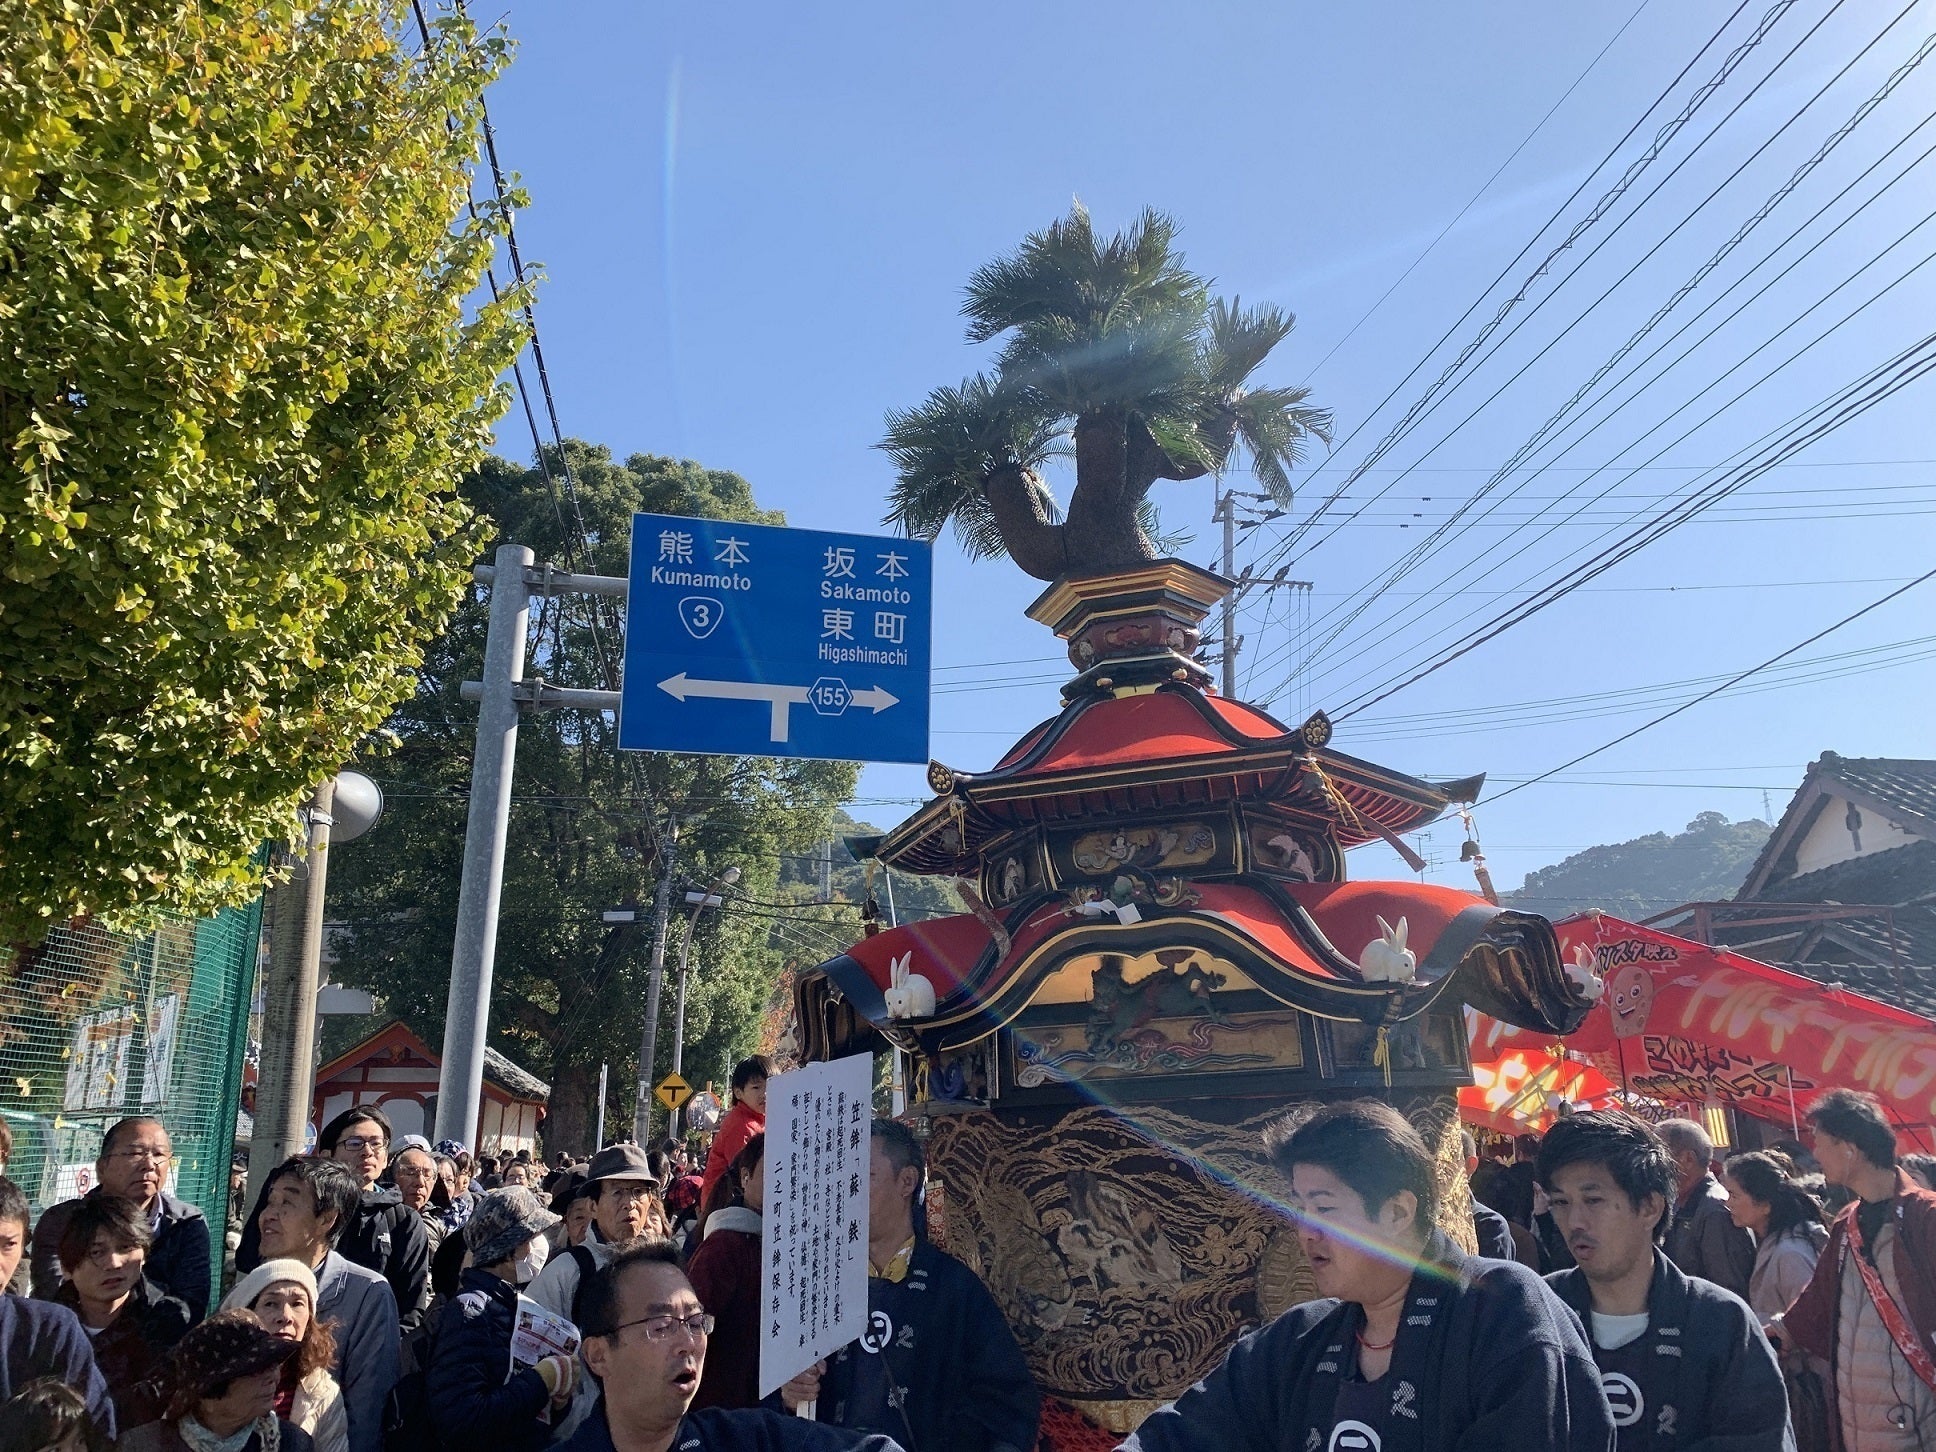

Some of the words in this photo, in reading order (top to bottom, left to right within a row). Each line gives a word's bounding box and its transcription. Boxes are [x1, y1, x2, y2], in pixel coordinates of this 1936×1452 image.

[658, 529, 750, 568] 熊本
[823, 546, 909, 582] 坂本
[652, 567, 751, 591] Kumamoto
[821, 582, 910, 604] Sakamoto
[693, 605, 710, 628] 3
[821, 608, 907, 643] 東町
[819, 643, 908, 666] Higashimachi
[815, 686, 845, 706] 155
